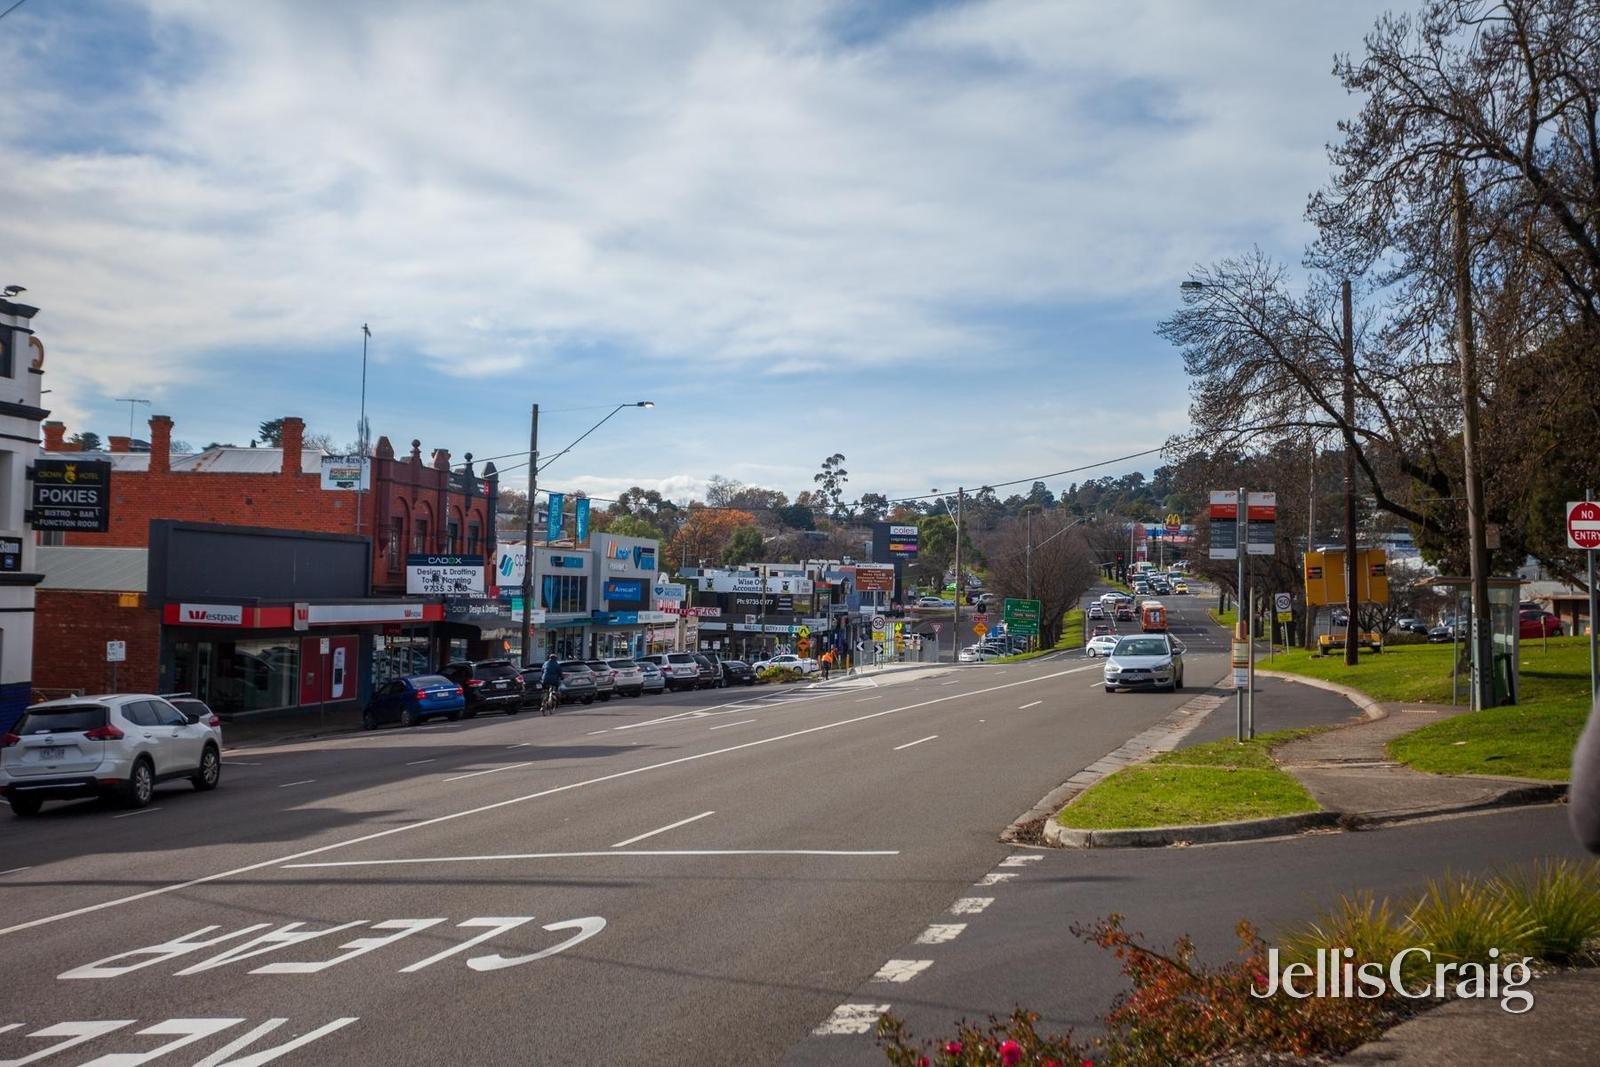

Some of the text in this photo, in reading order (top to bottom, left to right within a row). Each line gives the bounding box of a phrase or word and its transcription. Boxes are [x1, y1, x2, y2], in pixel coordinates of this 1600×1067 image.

[39, 489, 98, 503] POKIES
[44, 509, 71, 517] BISTRO
[1581, 510, 1594, 519] NO
[39, 519, 99, 528] FUNCTION ROOM
[893, 527, 915, 535] coles
[1574, 531, 1600, 540] ENTRY
[427, 556, 462, 565] CADOX
[416, 568, 441, 576] Design
[449, 568, 477, 577] Drafting
[738, 578, 754, 586] Wise
[732, 584, 773, 592] Accountats
[188, 610, 240, 623] Westpac
[56, 916, 607, 980] CLEAR
